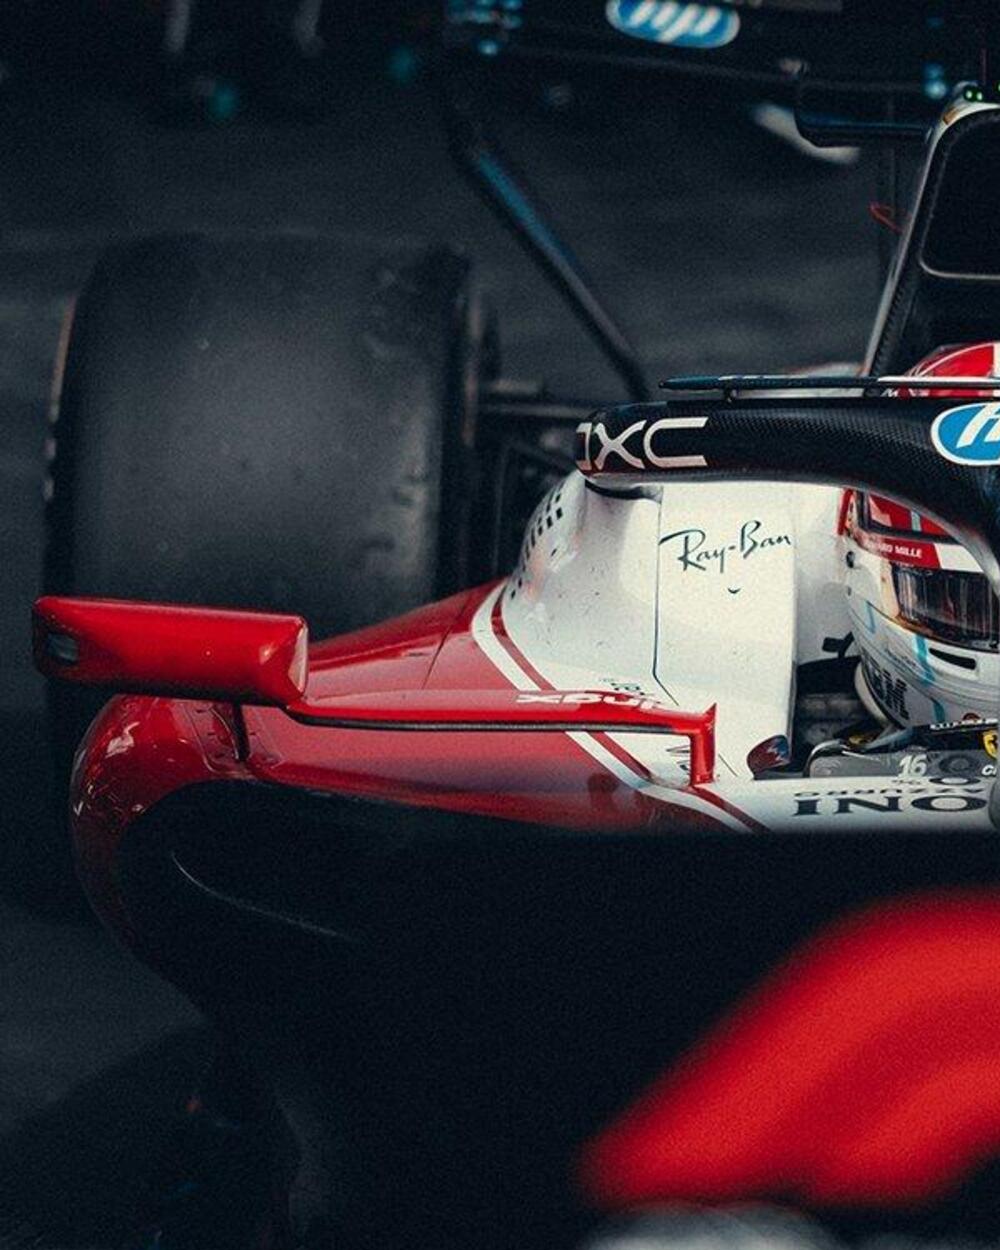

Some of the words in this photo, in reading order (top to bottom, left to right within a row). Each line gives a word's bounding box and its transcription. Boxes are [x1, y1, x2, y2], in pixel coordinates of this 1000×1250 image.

[658, 519, 791, 574] Ray-Ban
[894, 545, 922, 559] MILLE
[898, 754, 928, 778] 16
